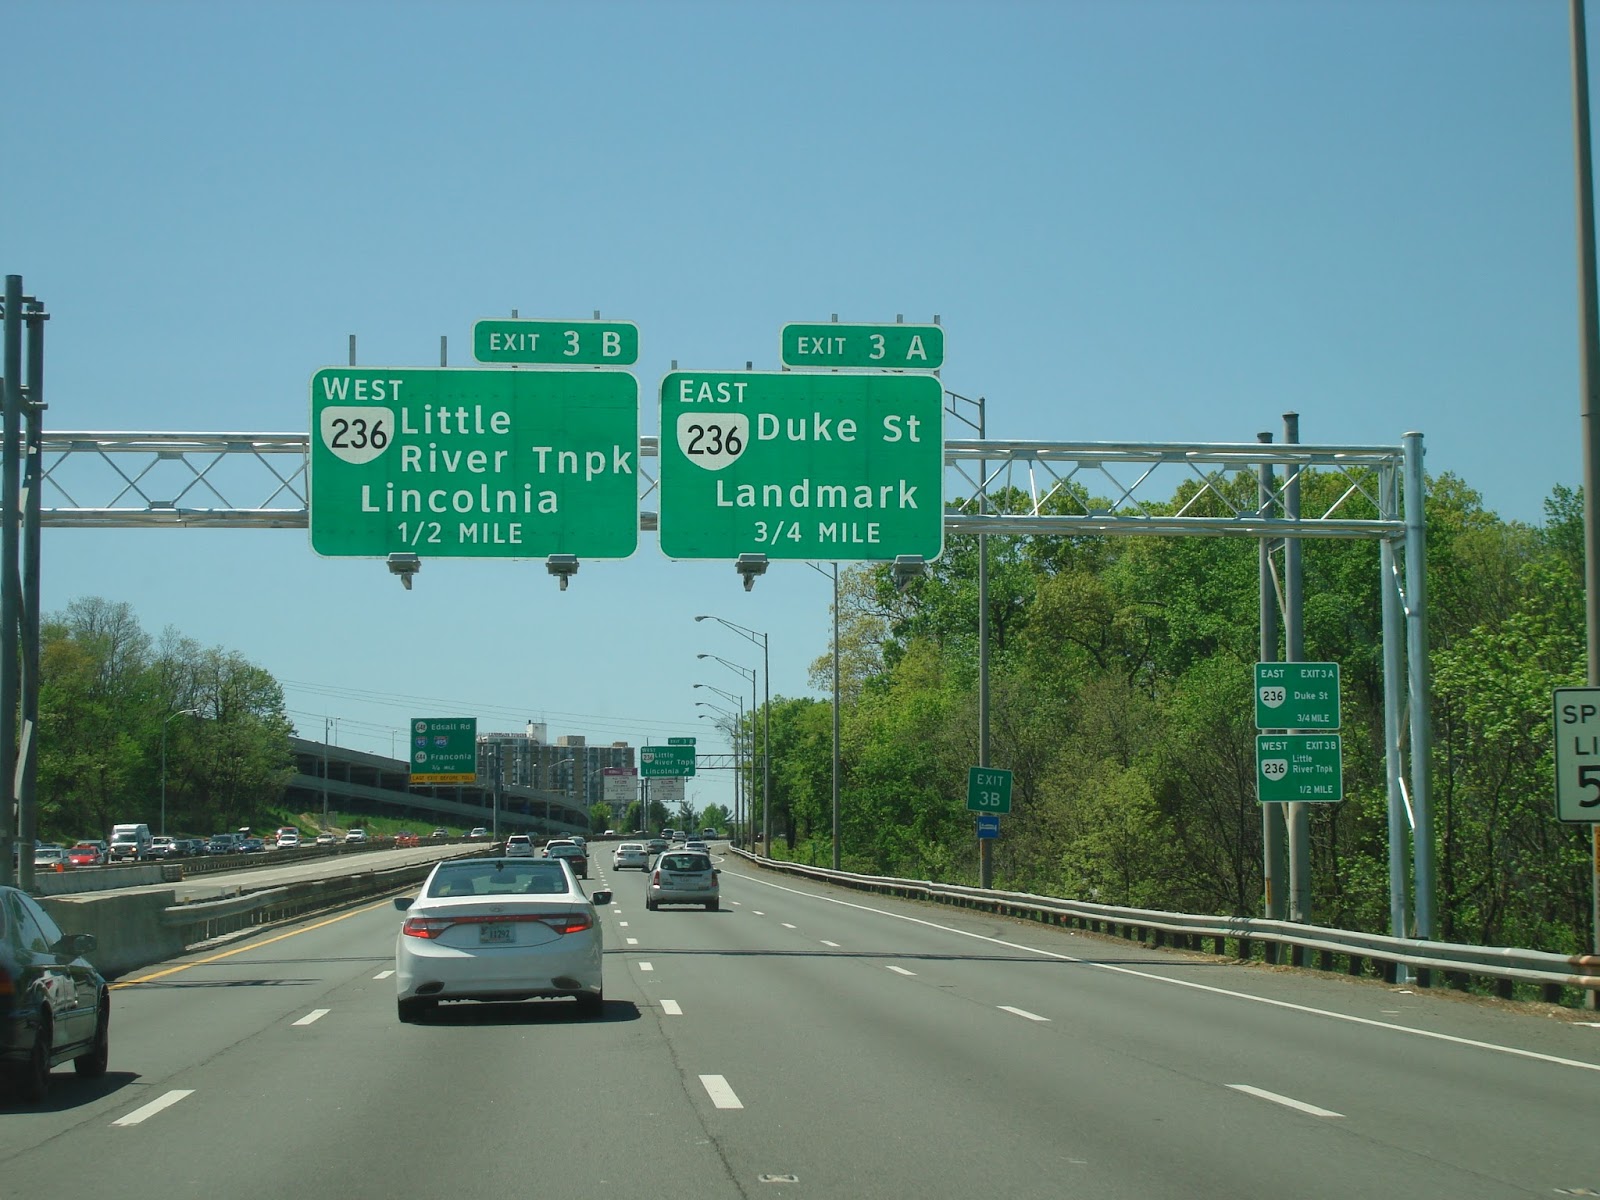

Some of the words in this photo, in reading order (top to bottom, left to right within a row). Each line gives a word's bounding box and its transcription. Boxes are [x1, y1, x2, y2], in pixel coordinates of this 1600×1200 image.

[489, 333, 540, 351] EXIT
[563, 331, 580, 356] 3
[602, 332, 621, 357] B
[798, 337, 847, 355] EXIT
[869, 334, 885, 359] 3
[906, 335, 927, 360] A
[322, 377, 403, 401] WEST
[679, 379, 748, 403] EAST
[401, 404, 511, 434] Little
[757, 412, 857, 442] Duke
[883, 414, 921, 443] St
[331, 418, 388, 449] 236
[687, 424, 742, 455] 236
[401, 443, 508, 473] River
[532, 445, 632, 482] Tnpk
[361, 482, 558, 514] Lincolnia
[716, 478, 918, 509] Landmark
[397, 521, 442, 545] 1/2
[459, 523, 523, 544] MILE
[754, 520, 802, 545] 3/4
[818, 522, 880, 543] MILE
[1261, 669, 1285, 678] EAST
[1300, 669, 1320, 678] EXIT
[1263, 691, 1283, 701] 236
[1294, 691, 1316, 700] Duke
[1318, 691, 1329, 700] St
[431, 723, 457, 731] Edsall
[1297, 714, 1311, 723] 3/4
[1311, 714, 1330, 722] MILE
[1261, 742, 1288, 750] WEST
[1306, 741, 1323, 750] EXIT
[1264, 763, 1285, 774] 236
[1292, 755, 1313, 763] Little
[1292, 765, 1313, 773] River
[1316, 765, 1333, 774] Tnpk
[977, 774, 1004, 787] EXIT
[1299, 785, 1312, 794] 1/2
[1313, 785, 1334, 794] MILE
[979, 791, 1000, 806] 3B
